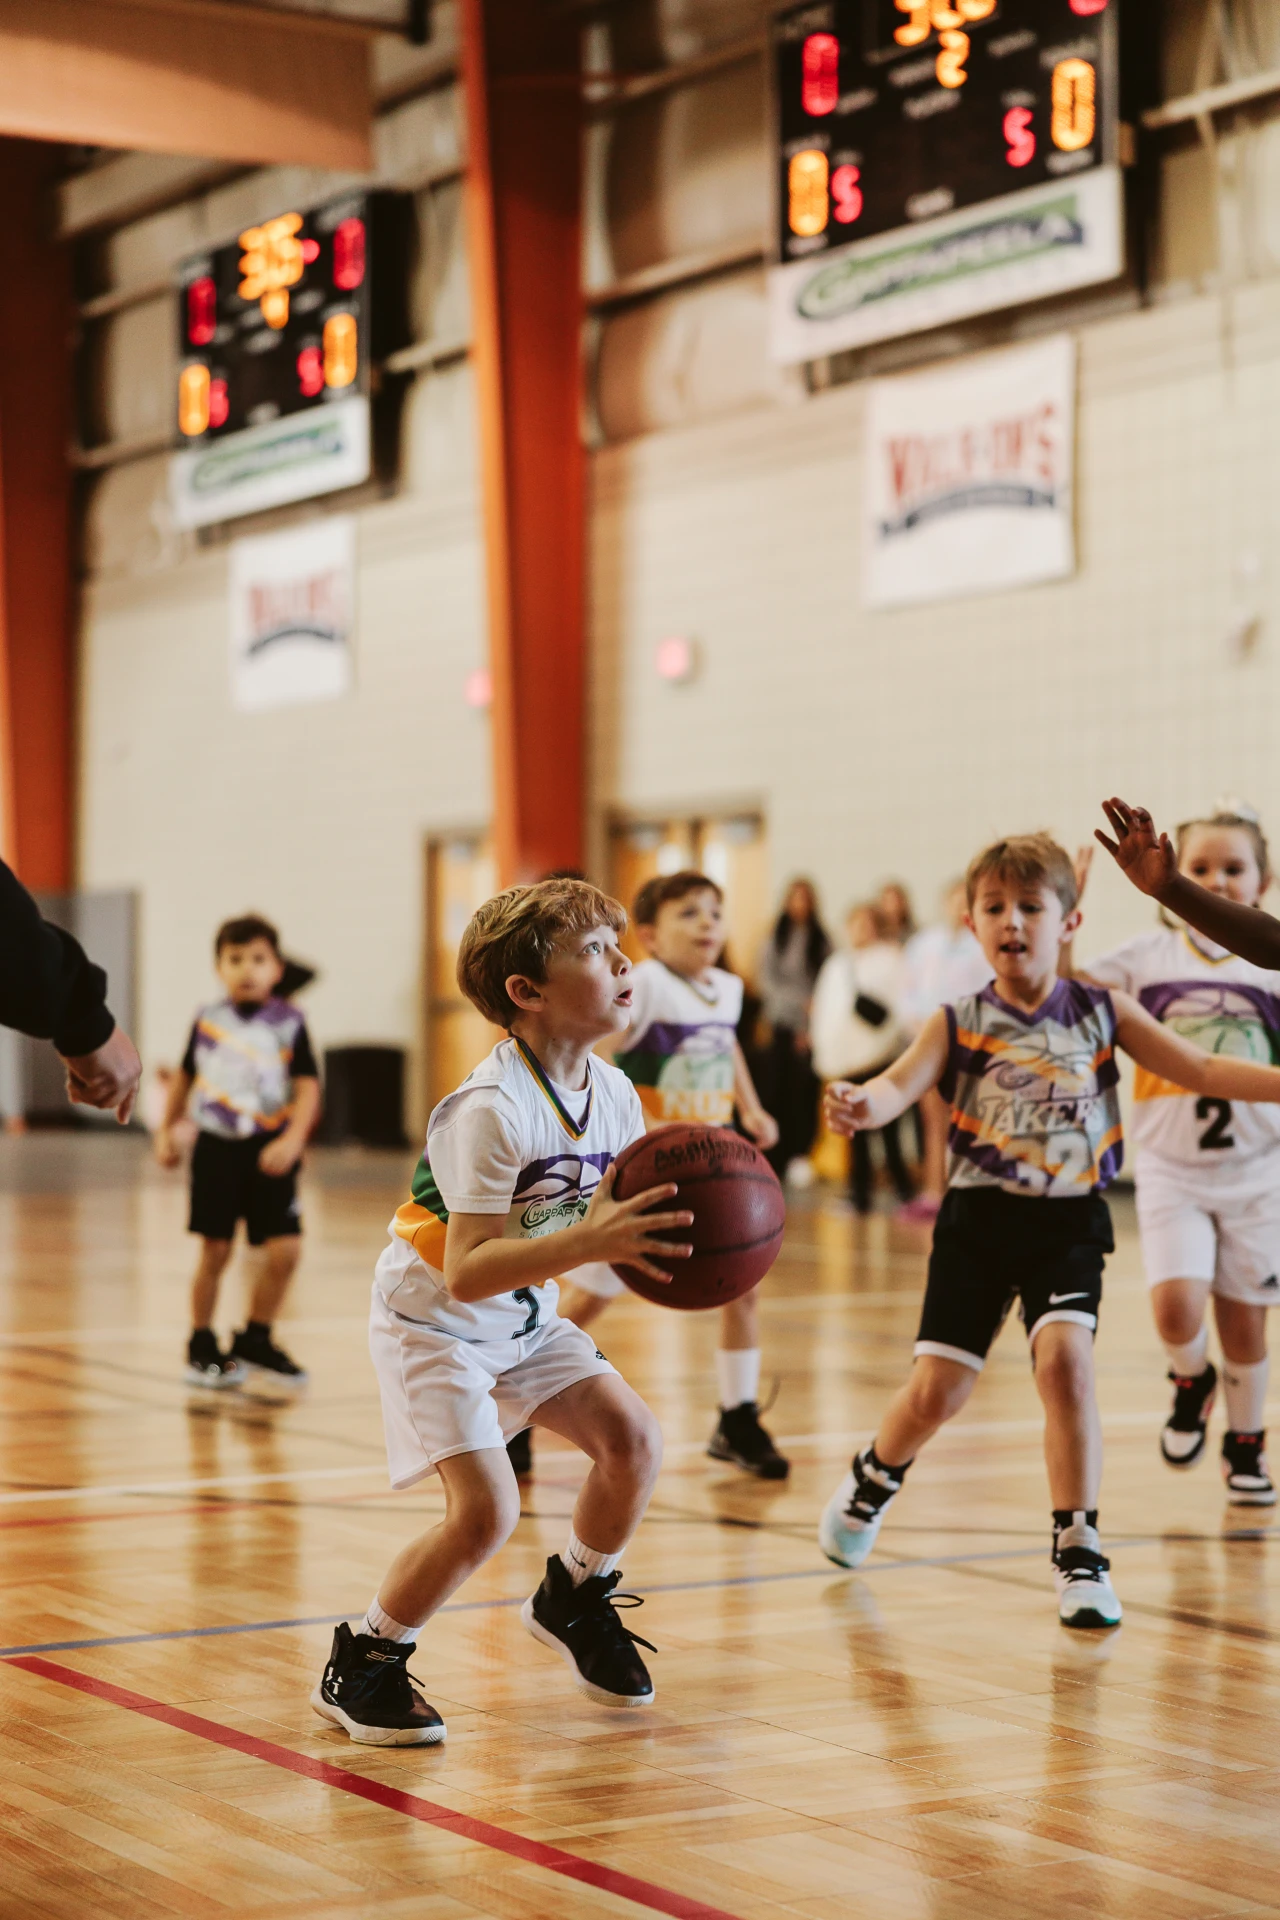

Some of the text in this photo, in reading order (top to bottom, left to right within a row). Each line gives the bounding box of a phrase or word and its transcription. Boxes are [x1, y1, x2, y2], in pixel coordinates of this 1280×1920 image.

[936, 30, 970, 88] 2
[1051, 59, 1095, 151] 0
[1003, 107, 1036, 167] 5
[832, 165, 863, 223] 5
[1195, 1097, 1235, 1150] 2
